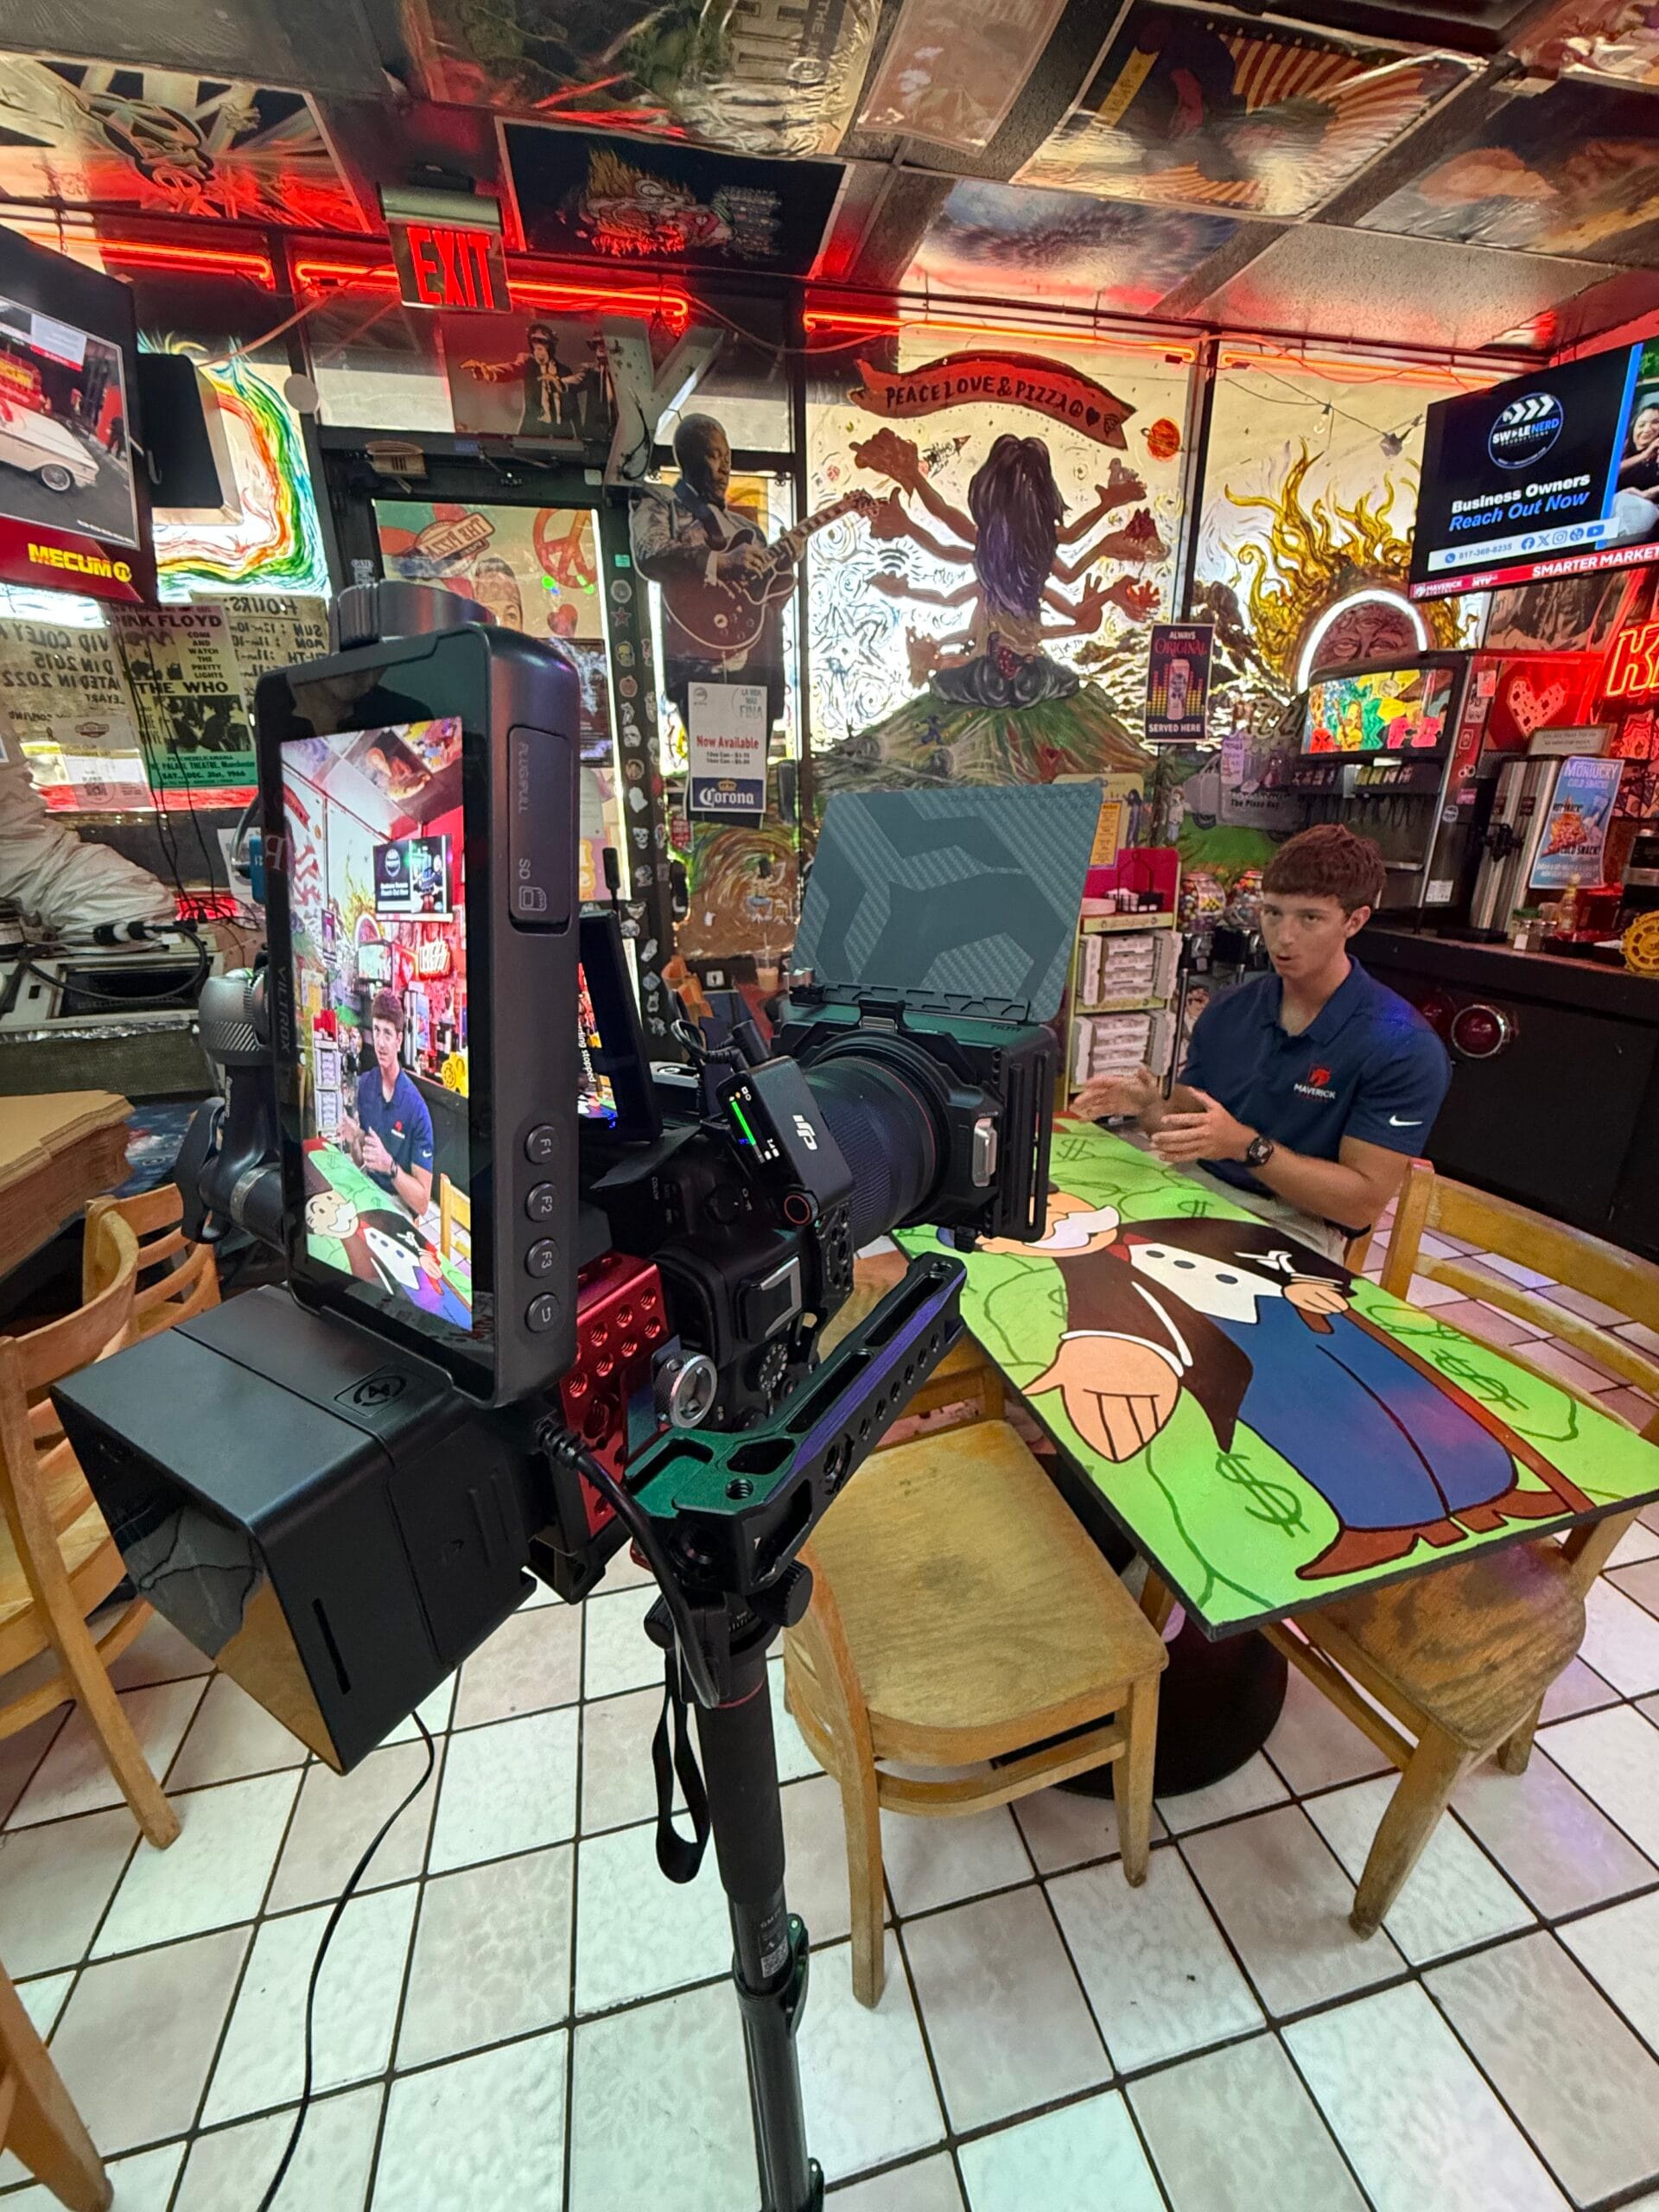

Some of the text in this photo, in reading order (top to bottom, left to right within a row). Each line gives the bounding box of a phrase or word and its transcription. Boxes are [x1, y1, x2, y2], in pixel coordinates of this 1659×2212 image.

[407, 226, 494, 309] EXIT
[887, 377, 1069, 412] PEACE LOVE & PIZZA
[1452, 474, 1591, 513] Business Owners
[1449, 492, 1590, 532] Reach Out Now
[28, 543, 112, 578] MECUM
[1532, 556, 1598, 578] SMARTER
[158, 614, 221, 627] FLOYD
[1169, 631, 1196, 639] ALWAYS
[135, 682, 229, 694] THE WHO
[1148, 723, 1201, 733] SERVED HERE
[696, 735, 760, 749] Now Available
[699, 787, 754, 808] Corona
[1230, 798, 1243, 807] The
[519, 858, 531, 880] SD
[276, 966, 291, 1054] VILTROX
[582, 1048, 597, 1084] stopped
[1294, 1083, 1336, 1100] MAVERICK
[540, 1138, 551, 1154] F1
[541, 1196, 552, 1213] F2
[542, 1251, 552, 1268] F3
